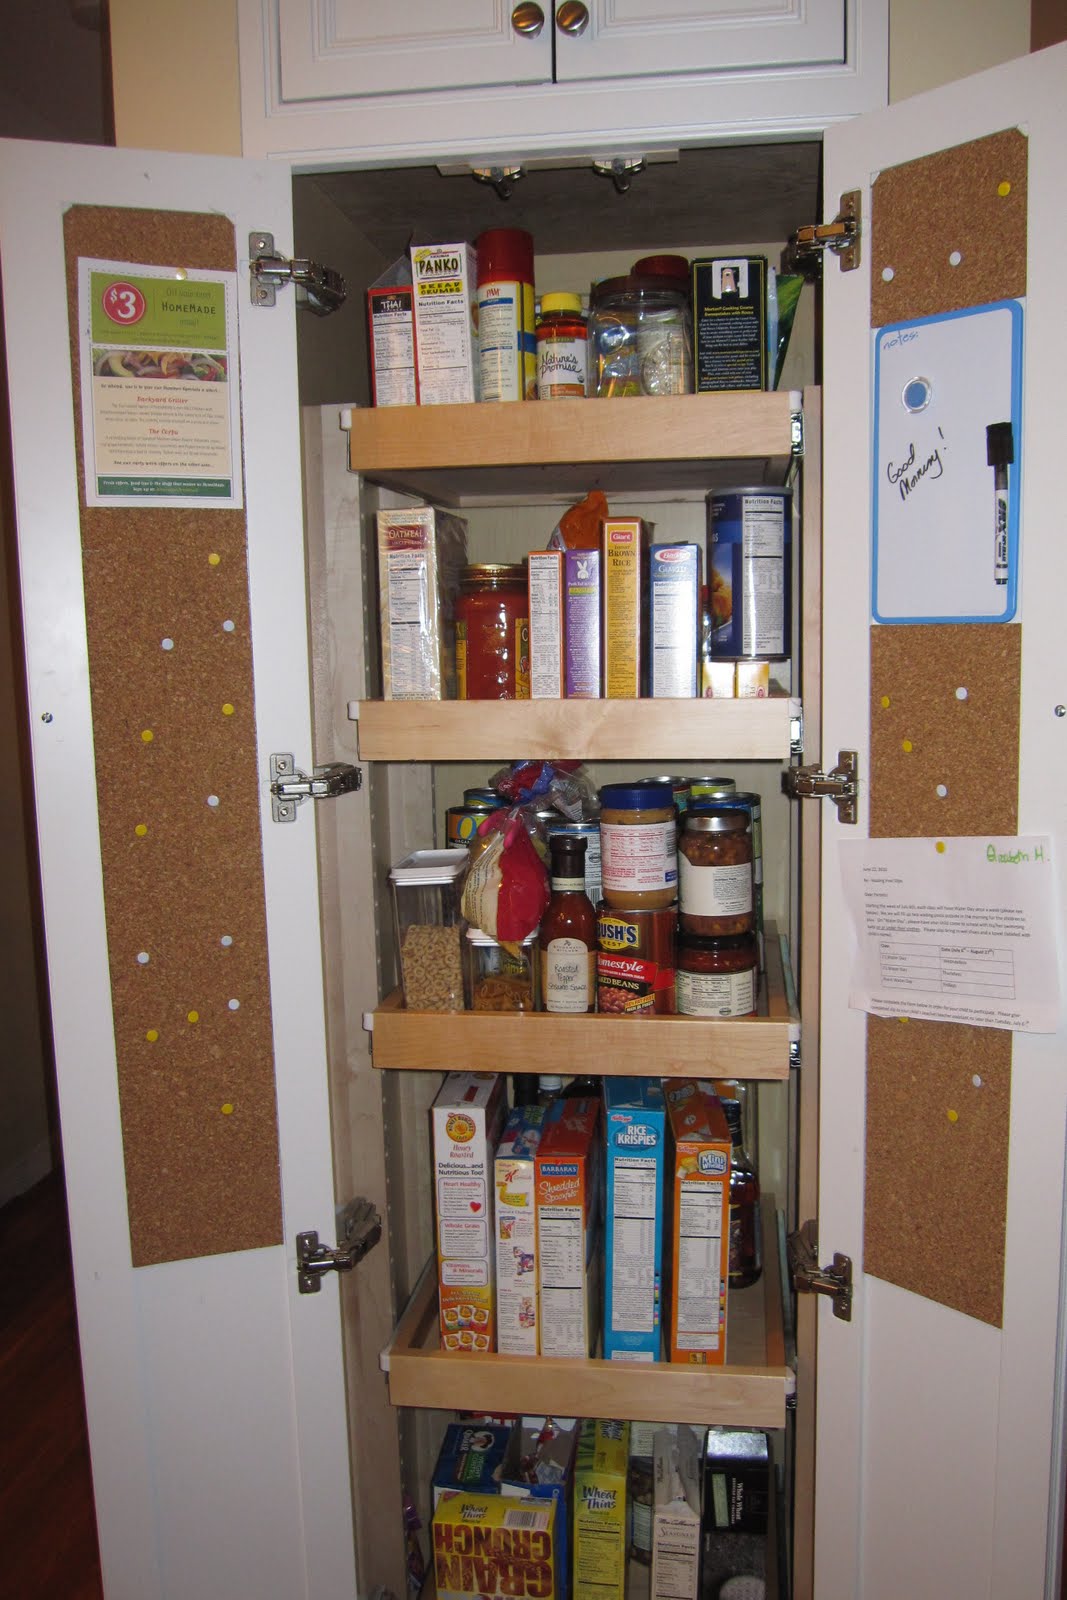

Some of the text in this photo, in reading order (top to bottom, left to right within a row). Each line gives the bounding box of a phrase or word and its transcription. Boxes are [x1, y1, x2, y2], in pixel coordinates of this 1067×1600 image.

[419, 258, 459, 274] PANKO
[420, 288, 461, 296] CRUMBS
[486, 288, 500, 298] PAM
[110, 288, 136, 319] $3
[380, 300, 402, 310] THAI
[884, 331, 919, 350] notes:
[541, 351, 579, 366] Nature's
[887, 443, 915, 484] Good
[388, 529, 424, 539] OATMEAL
[612, 533, 632, 541] Giant
[608, 549, 636, 557] BROWN
[612, 559, 631, 567] RICE
[602, 939, 622, 947] BEST
[612, 979, 640, 990] BEANS
[626, 1125, 647, 1135] RICE
[617, 1134, 657, 1146] KRISPIES
[453, 1144, 473, 1152] Honey
[542, 1165, 577, 1173] BARBARA'S
[582, 1486, 618, 1501] Wheat
[581, 1498, 618, 1510] Thins
[735, 1482, 745, 1520] Whole Wheat
[460, 1503, 489, 1514] Wheat
[461, 1511, 488, 1520] Thins
[433, 1522, 552, 1562] CRUNCH
[435, 1552, 552, 1598] GRAIN
